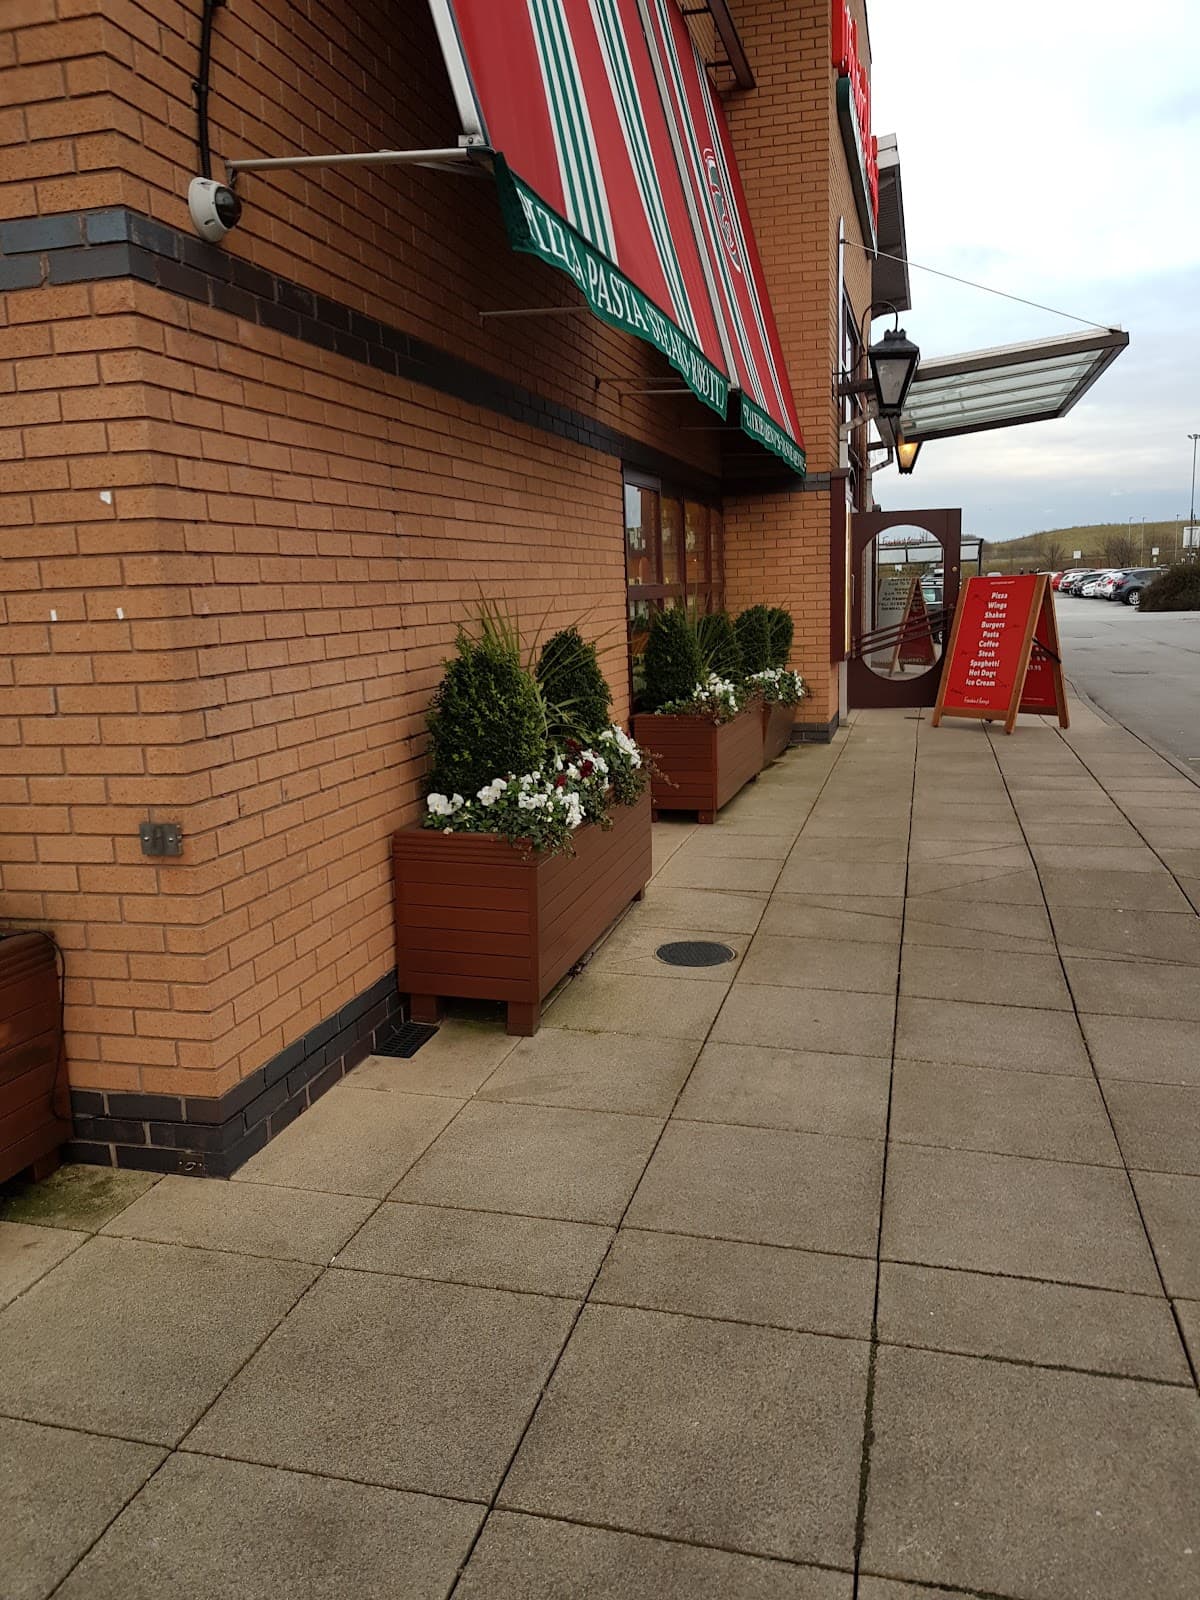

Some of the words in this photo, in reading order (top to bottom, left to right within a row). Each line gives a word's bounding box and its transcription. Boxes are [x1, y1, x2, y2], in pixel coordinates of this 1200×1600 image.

[586, 253, 649, 332] PASTA
[645, 302, 690, 377] STEAKS
[988, 602, 1007, 610] Wings
[981, 621, 1005, 629] Burgers
[979, 640, 999, 648] Coffee
[970, 659, 1000, 667] Spaghetti
[981, 669, 996, 678] Dogs
[975, 679, 996, 687] Cream
